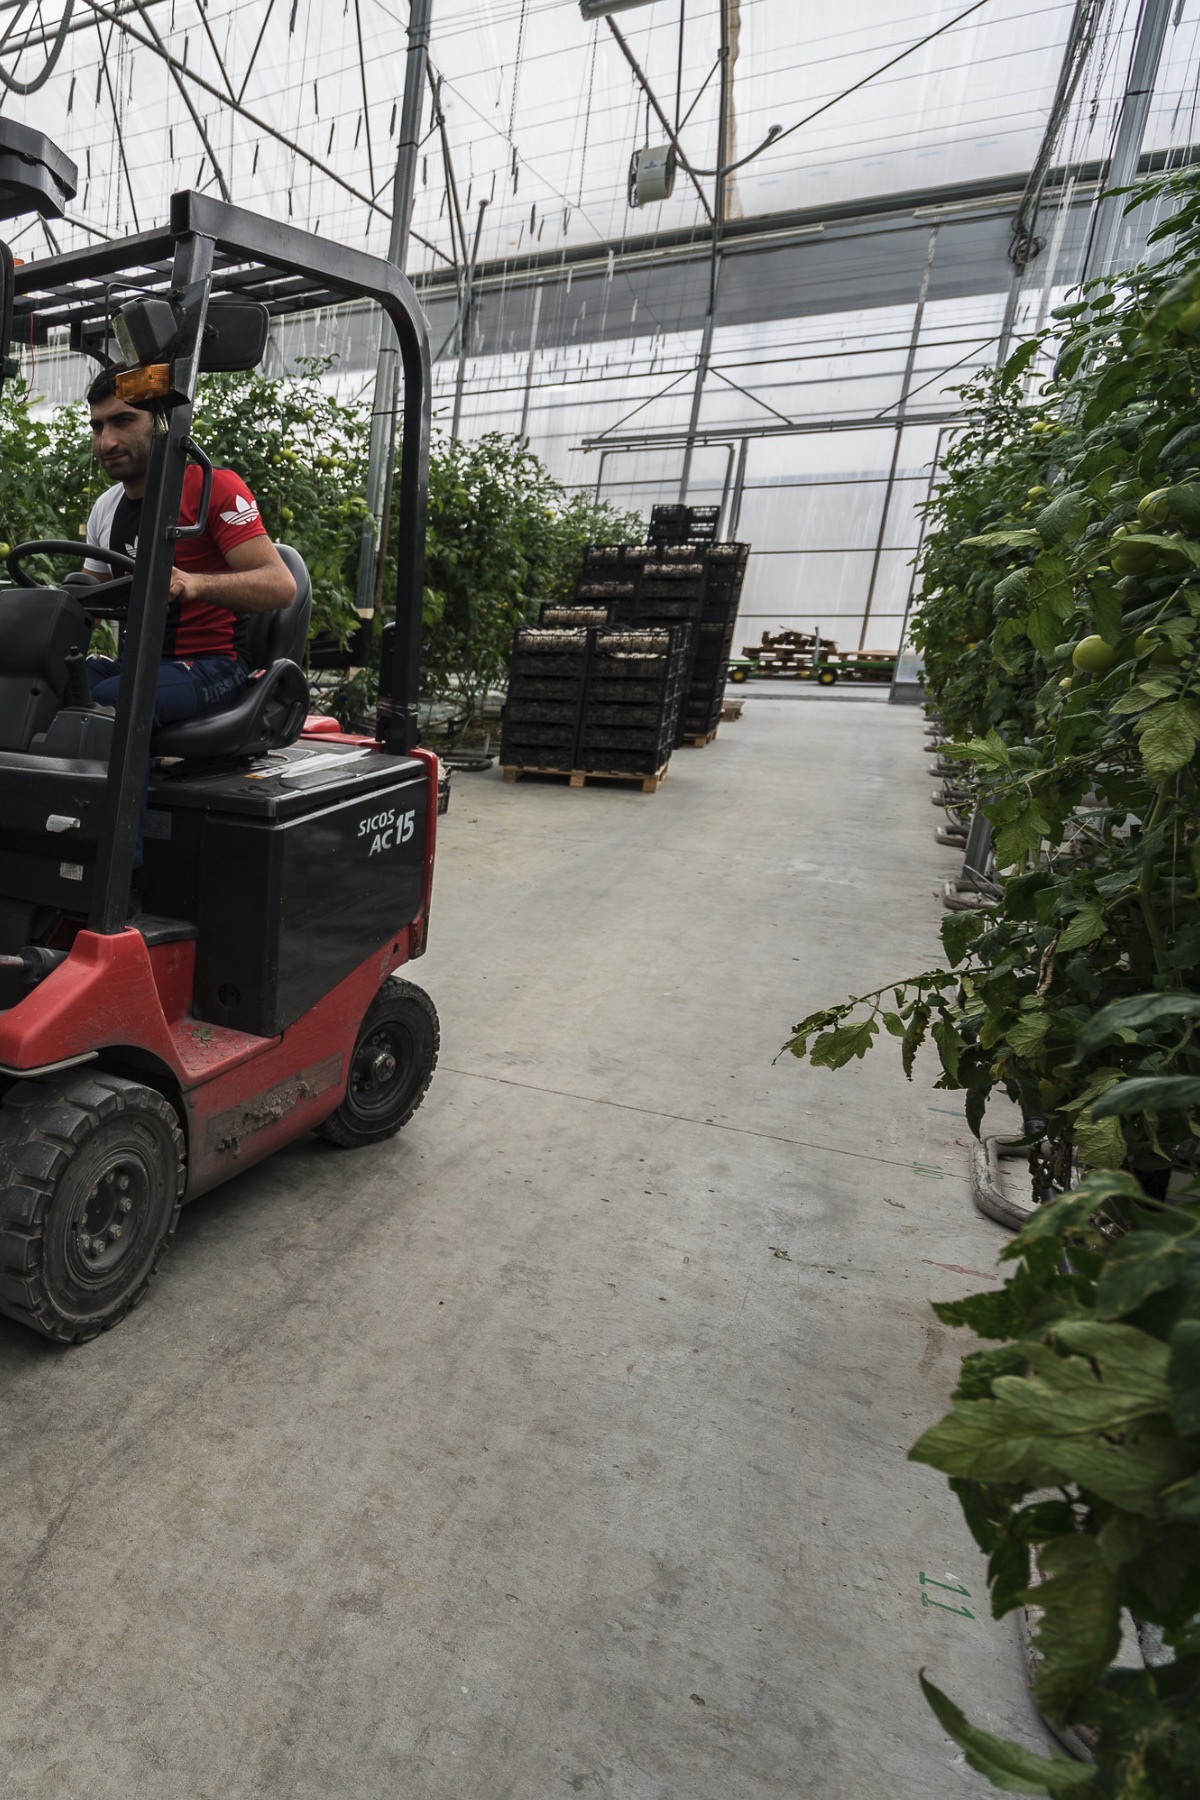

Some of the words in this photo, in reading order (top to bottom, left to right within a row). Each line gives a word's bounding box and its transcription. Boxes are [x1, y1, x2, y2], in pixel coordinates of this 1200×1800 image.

[358, 808, 395, 837] SICOS
[369, 828, 394, 857] AC
[396, 809, 416, 845] 15
